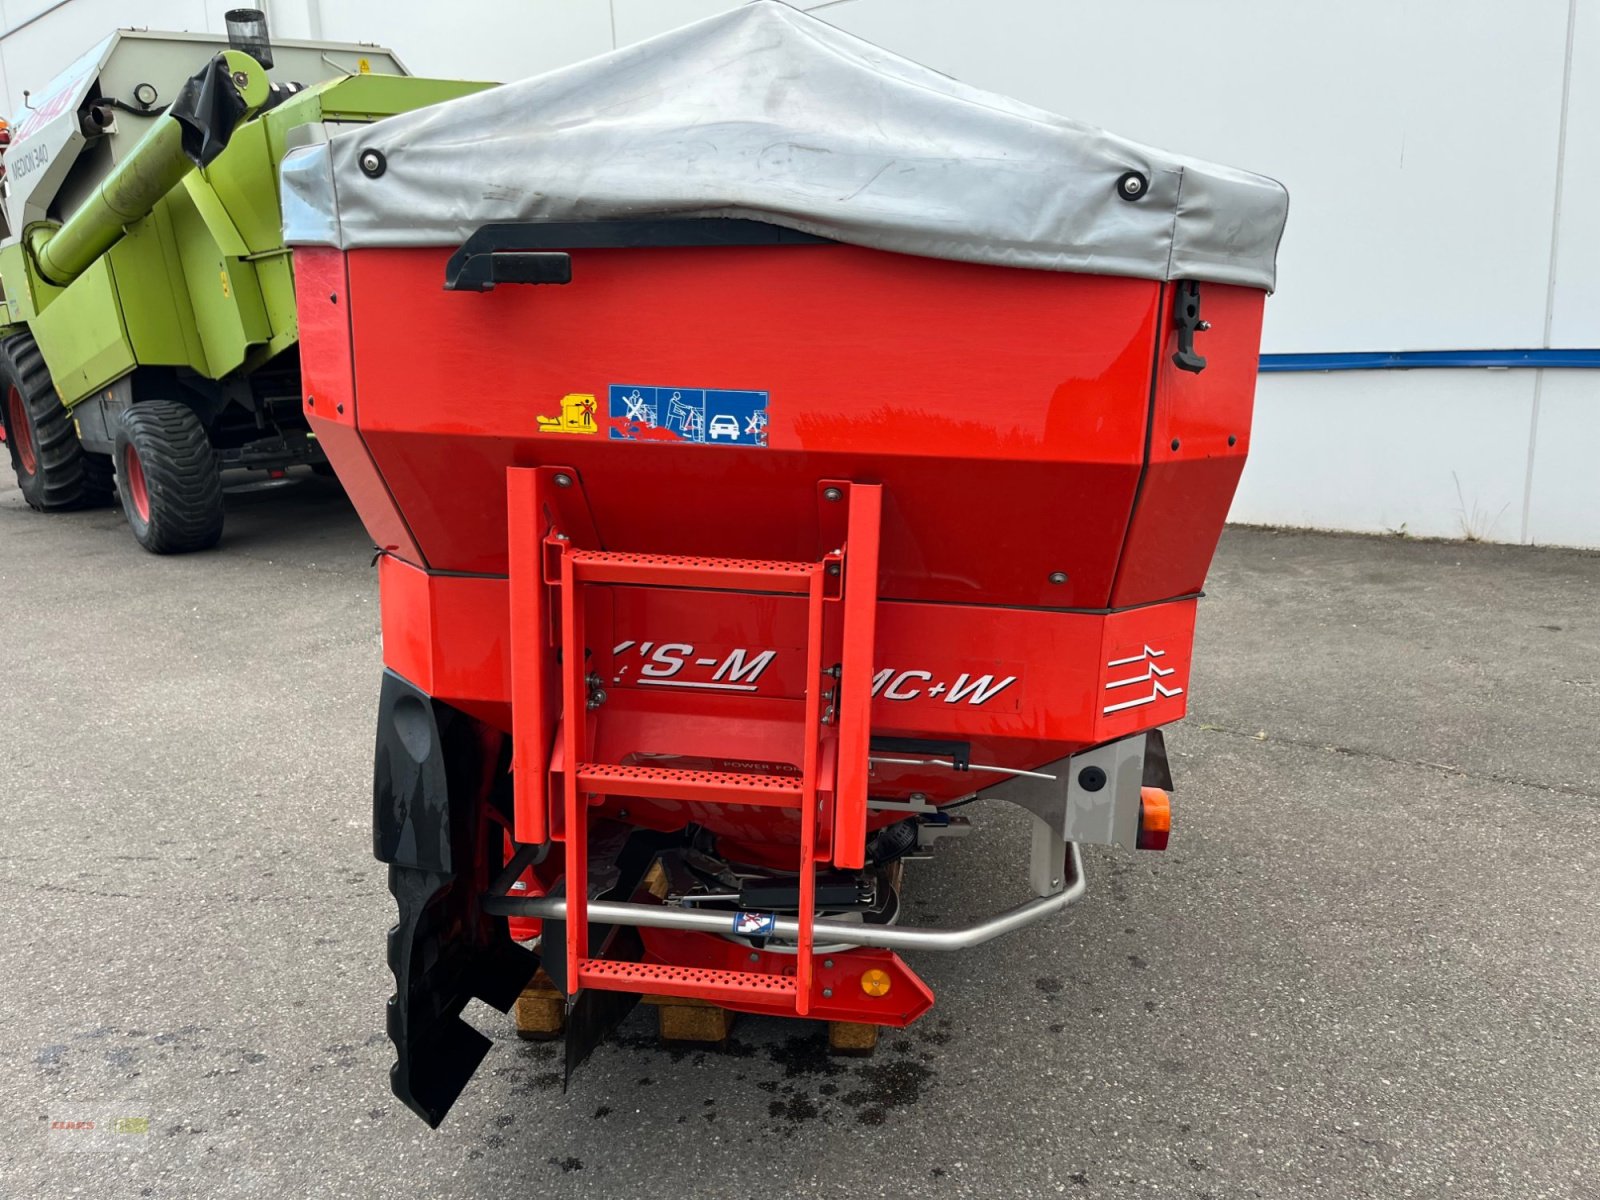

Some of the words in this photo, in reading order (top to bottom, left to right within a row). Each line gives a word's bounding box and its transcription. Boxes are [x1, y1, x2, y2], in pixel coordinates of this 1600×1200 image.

[11, 153, 36, 180] MEDION
[33, 144, 49, 168] 340
[723, 761, 769, 770] POWER
